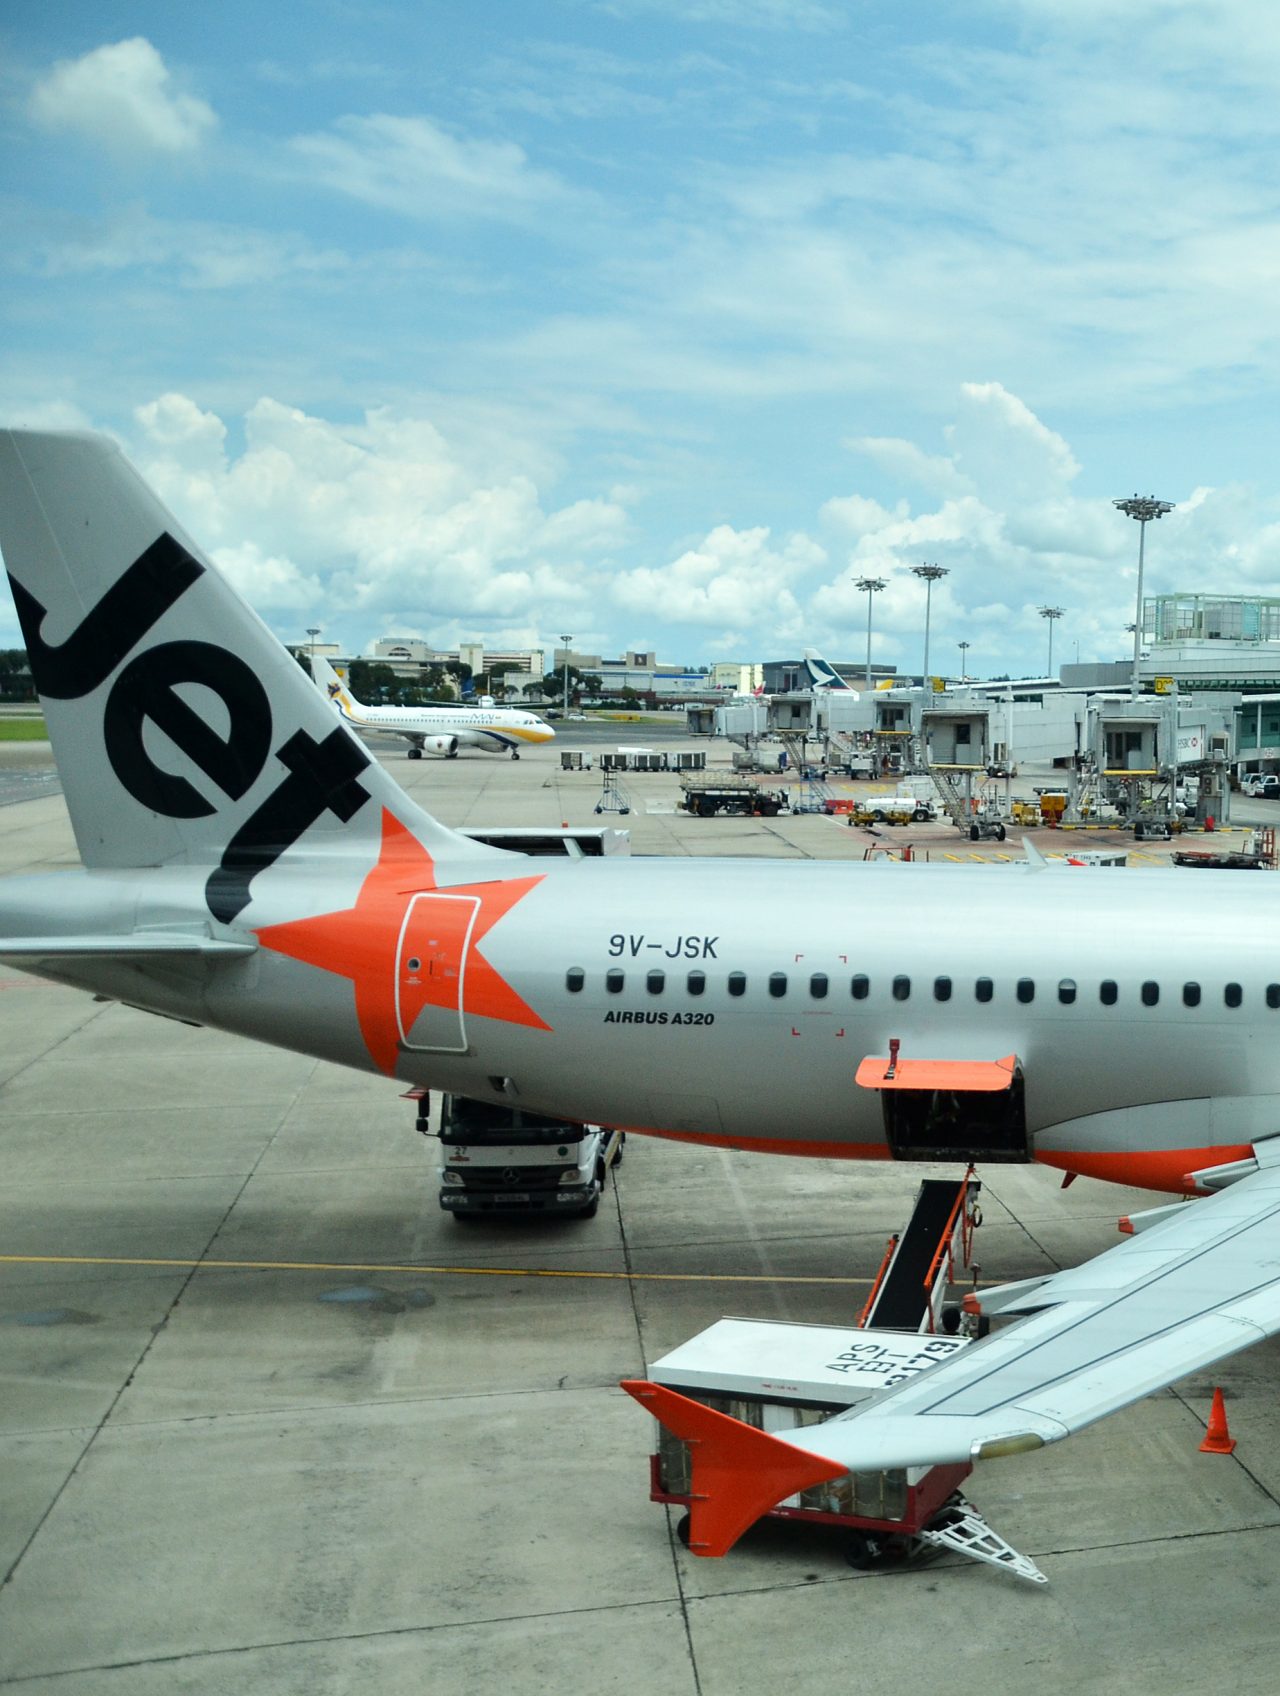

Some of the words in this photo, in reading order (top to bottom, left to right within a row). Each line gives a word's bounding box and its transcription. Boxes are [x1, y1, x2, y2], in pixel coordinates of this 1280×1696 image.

[8, 531, 371, 924] Jet
[608, 934, 719, 958] 9V-JSK
[604, 1010, 669, 1025] AIRBUS
[671, 1013, 715, 1026] A320
[825, 1343, 881, 1373] APS
